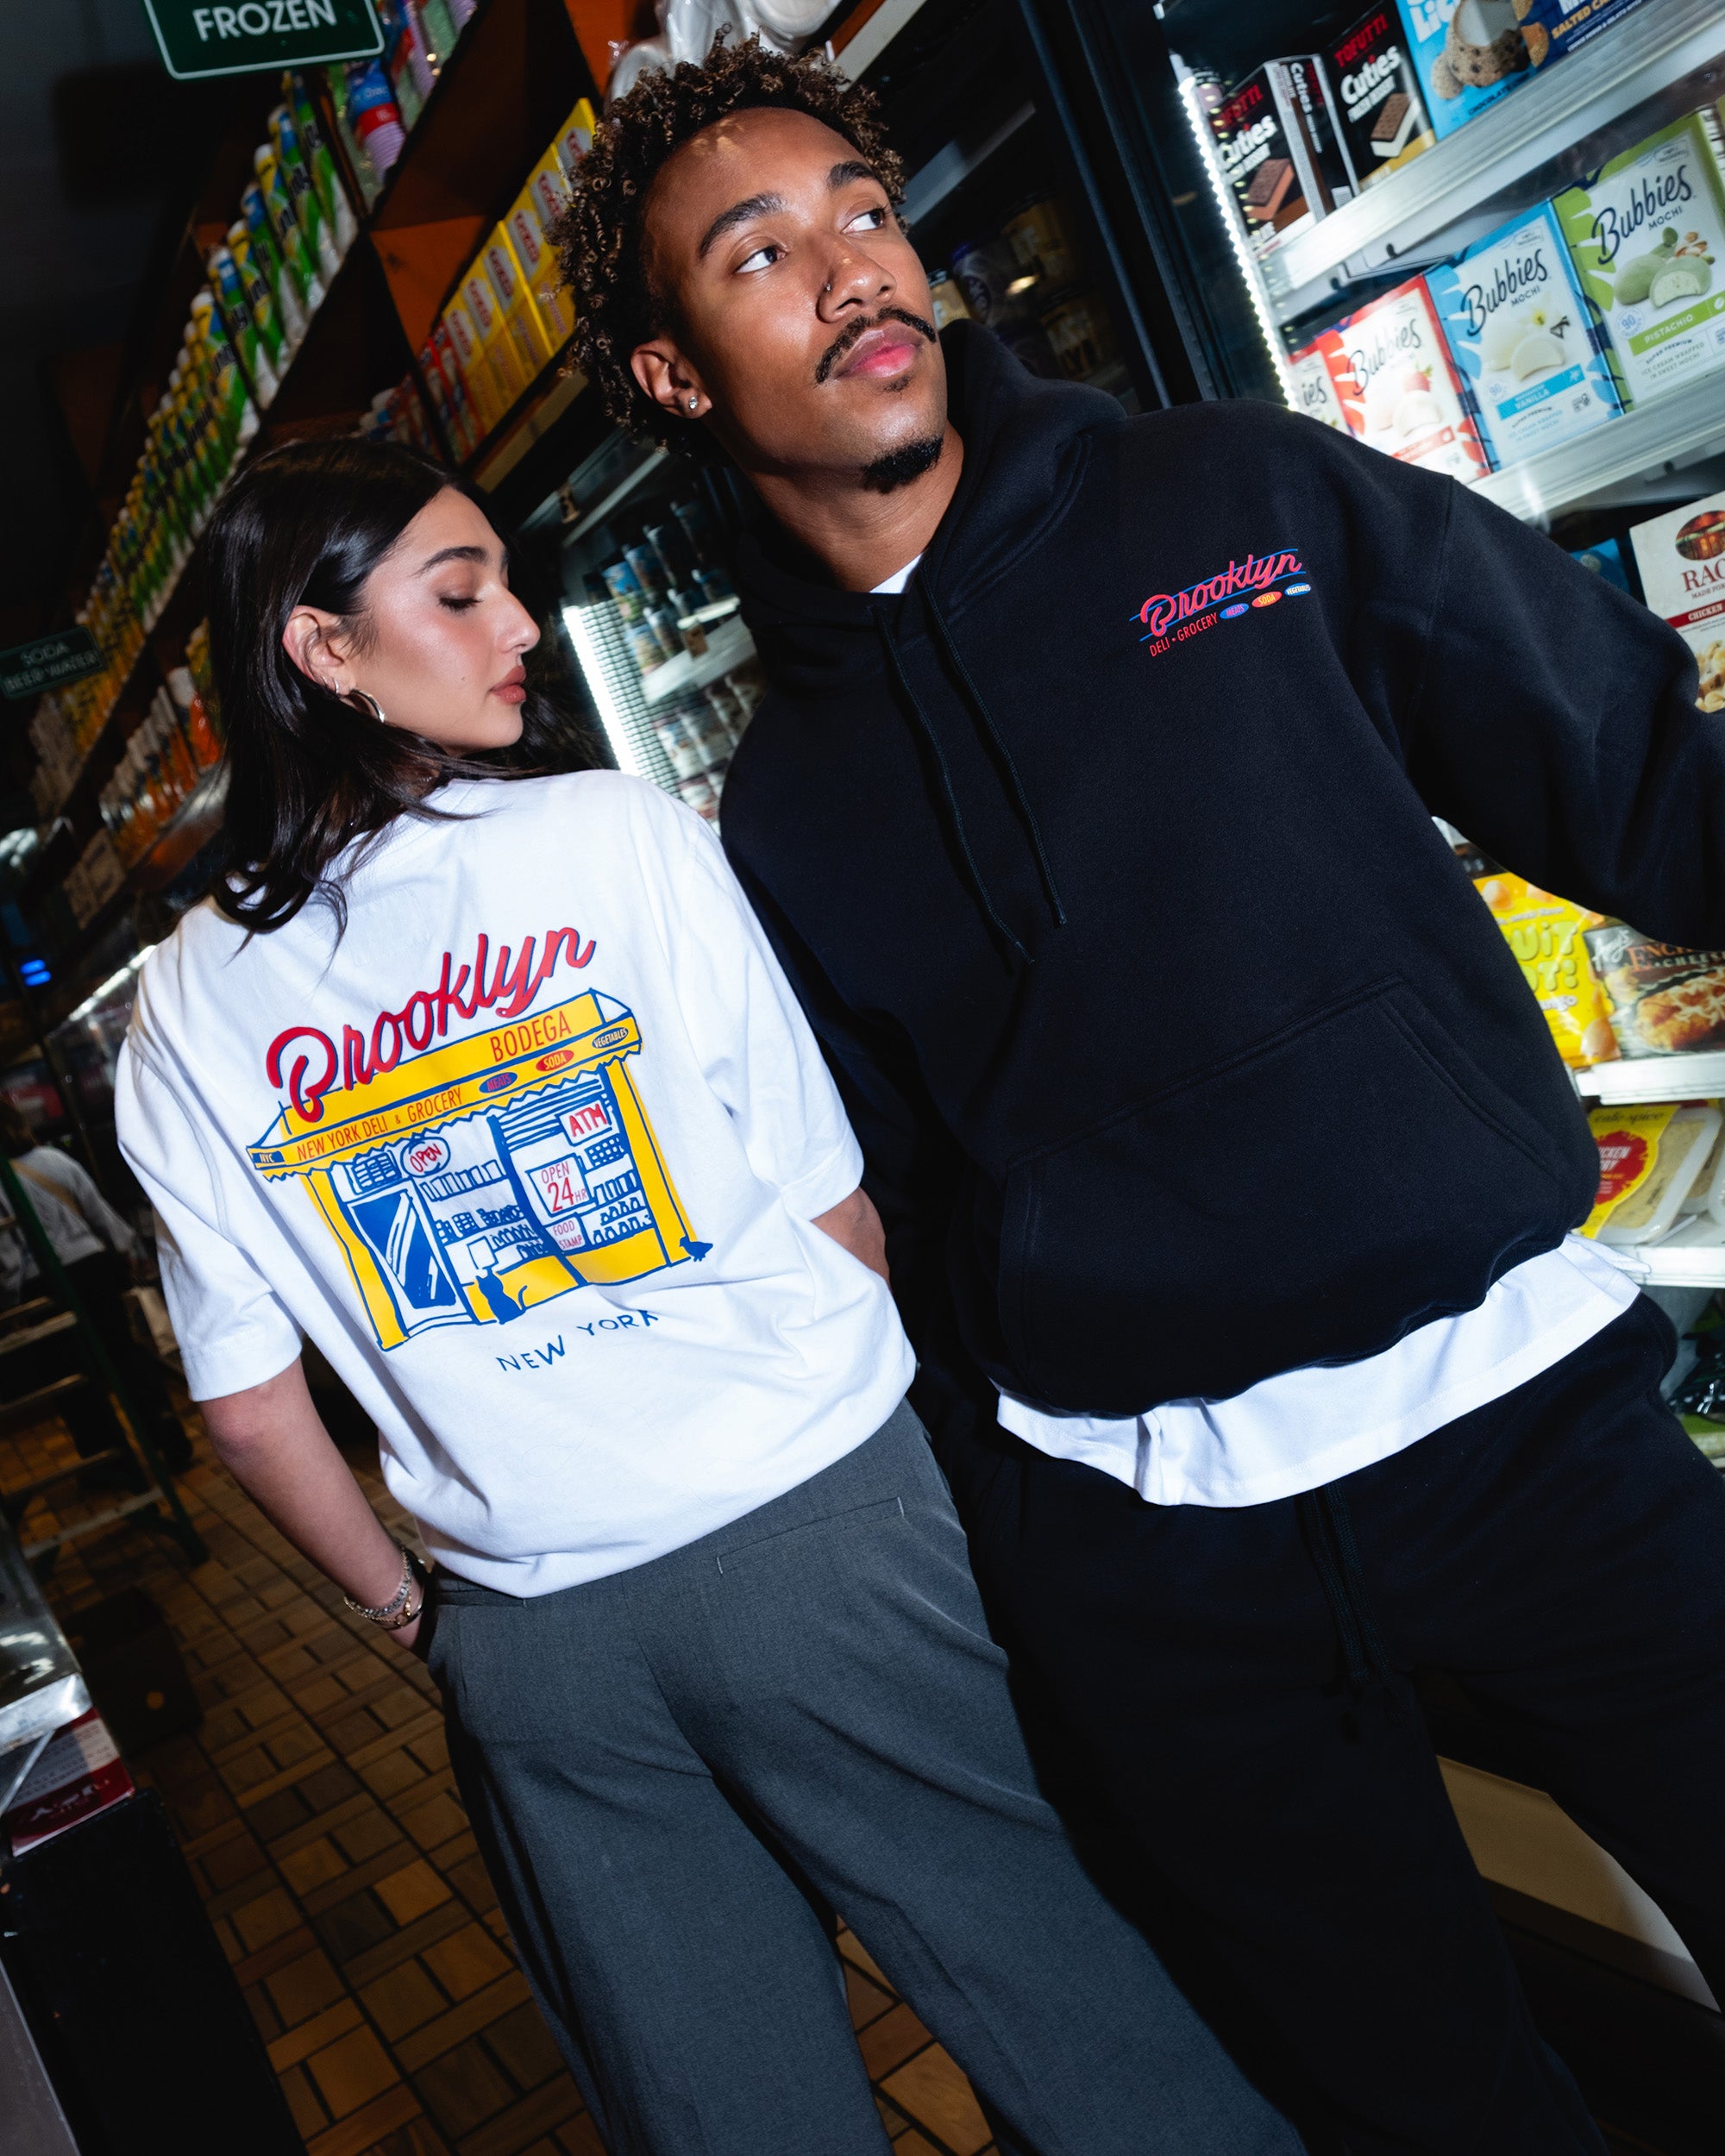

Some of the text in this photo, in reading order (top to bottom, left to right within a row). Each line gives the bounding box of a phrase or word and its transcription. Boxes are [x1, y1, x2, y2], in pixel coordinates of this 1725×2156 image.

[192, 0, 337, 41] FROZEN
[1551, 5, 1591, 40] SALTED
[1334, 14, 1389, 67] TOFUTTI
[1290, 62, 1314, 114] Cuties
[1340, 46, 1402, 104] Cuties
[1218, 115, 1276, 170] Cuties
[1590, 165, 1692, 265] Bubbies
[1648, 206, 1684, 230] MOCHI
[1460, 248, 1547, 336] Bubbies
[1511, 285, 1540, 307] MOCHI
[1644, 314, 1693, 343] PISTACHIO
[1346, 318, 1422, 396] Bubbies
[1140, 554, 1302, 636] Brooklyn
[1226, 605, 1245, 617] MEATS
[1258, 594, 1276, 605] SODA
[1688, 603, 1723, 622] CHICKEN
[1150, 612, 1219, 657] DELI GROCERY
[266, 927, 596, 1122] Brooklyn
[490, 1011, 571, 1062] BODEGA
[593, 1028, 629, 1049] VEGETABLES
[543, 1053, 568, 1070] SODA
[486, 1073, 511, 1092] MEATS
[297, 1087, 463, 1161] NEW YORK DELI & GROCERY
[569, 1103, 607, 1137] ATM
[260, 1152, 274, 1163] NYC
[410, 1143, 442, 1173] OPEN
[541, 1162, 570, 1184] OPEN
[548, 1177, 574, 1212] 24
[553, 1220, 575, 1236] FOOD
[560, 1234, 582, 1250] STAMP
[496, 1335, 565, 1371] NEW
